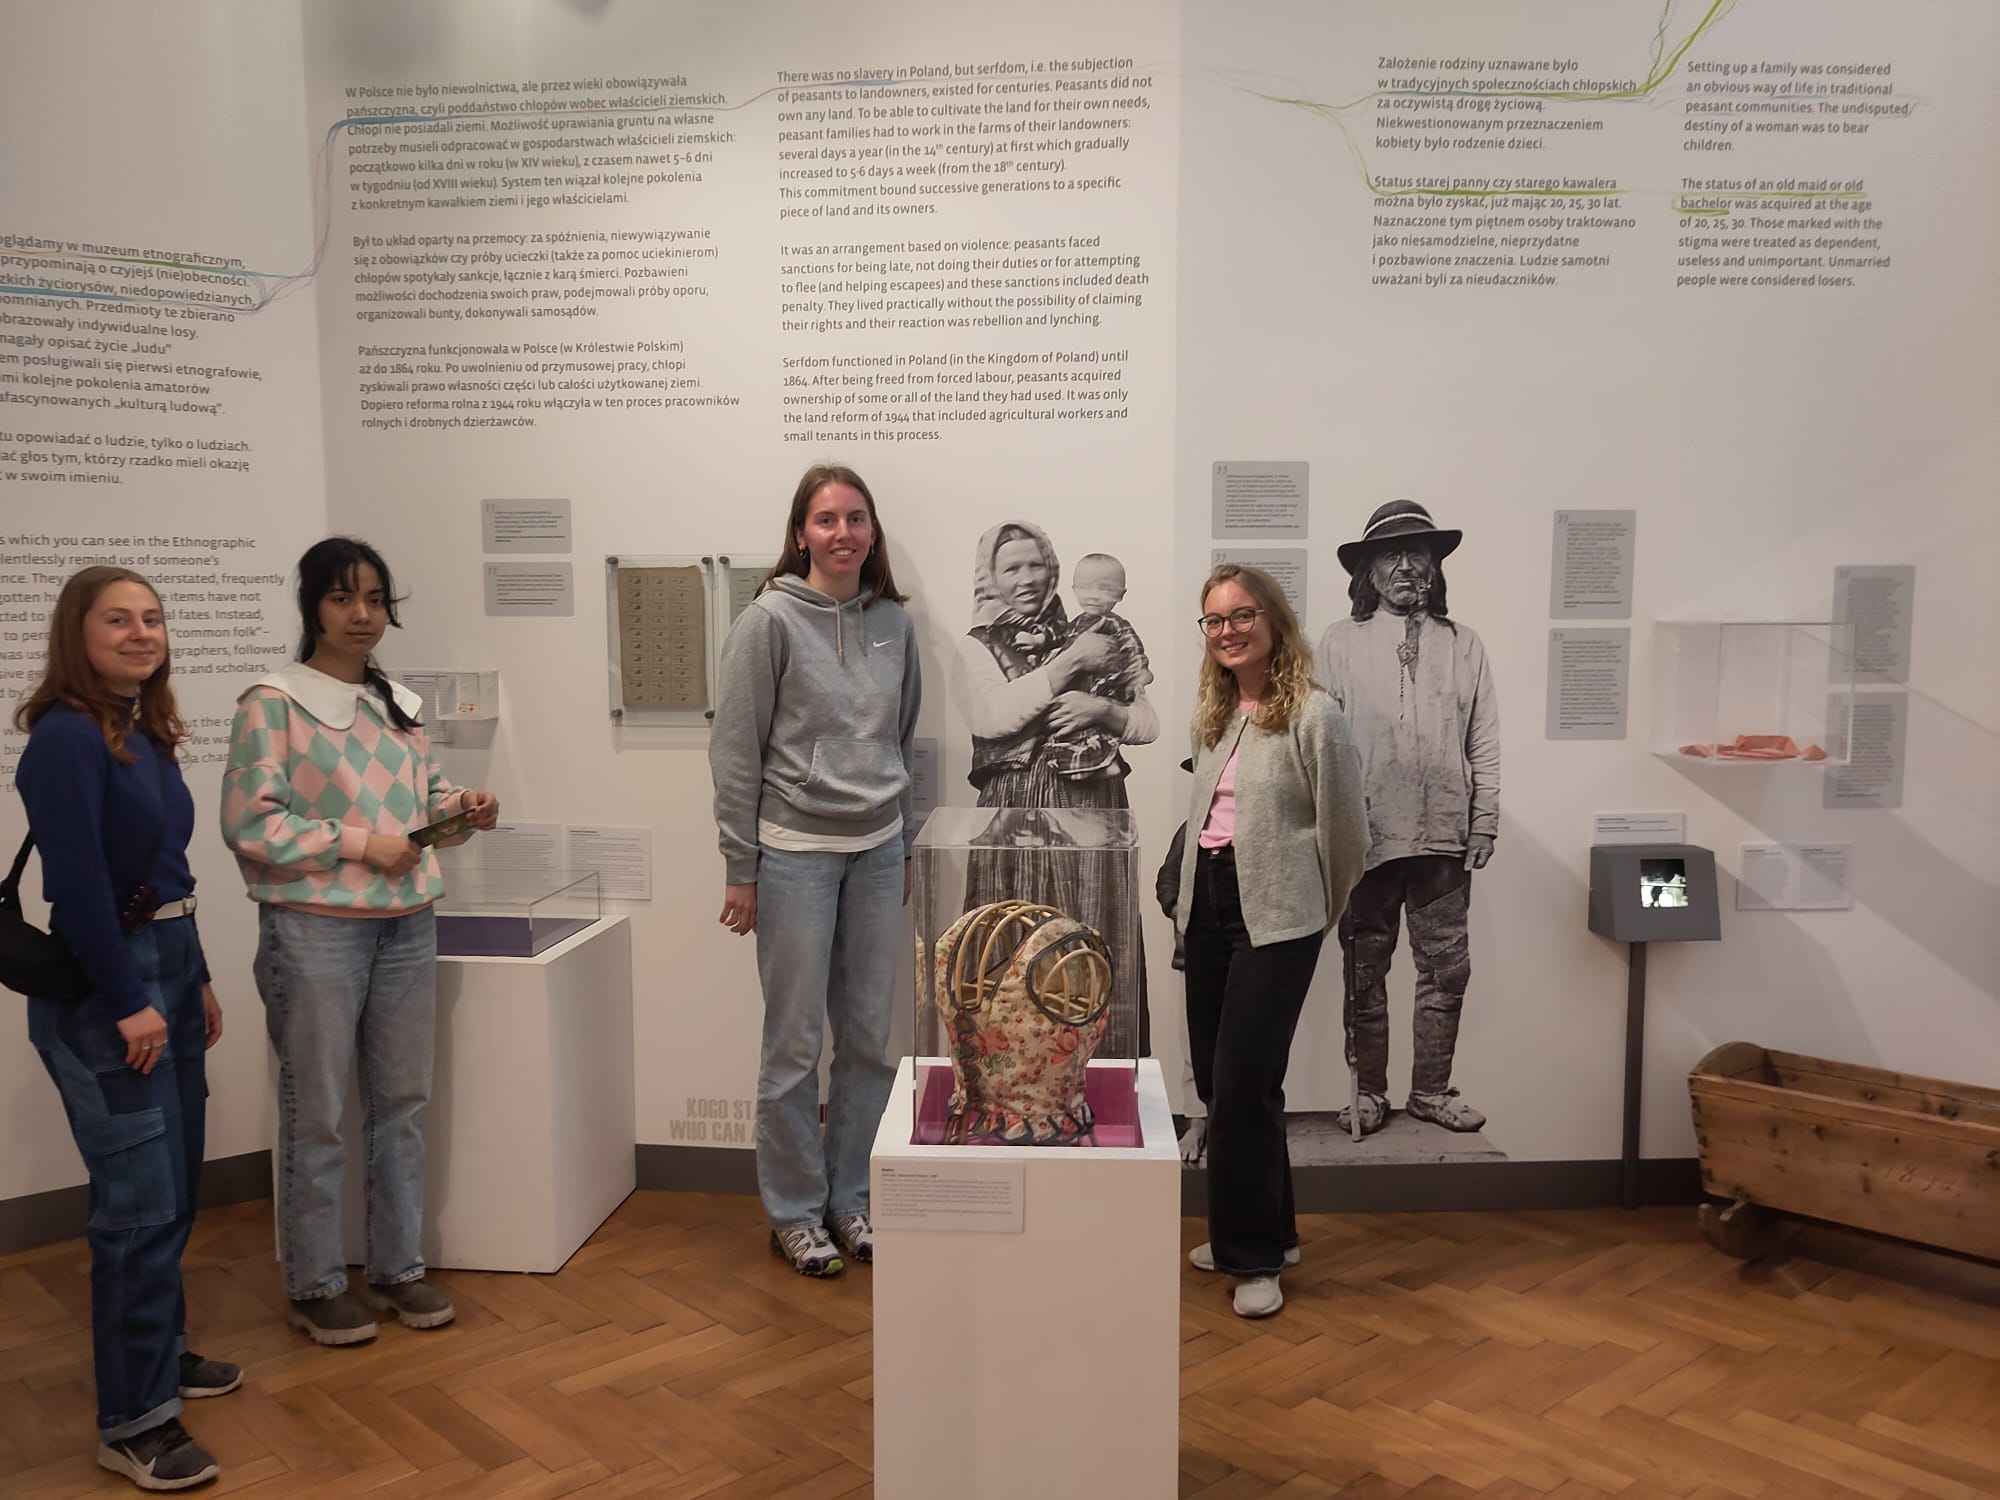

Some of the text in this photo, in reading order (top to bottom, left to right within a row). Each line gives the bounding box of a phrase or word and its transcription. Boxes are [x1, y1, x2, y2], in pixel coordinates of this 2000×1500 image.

[777, 55, 1133, 82] There was no slavery in Poland, but serfdom, i.e. the subjection
[1687, 59, 1891, 76] Setting up a family was considered
[777, 74, 1152, 104] of peasants to landowners, existed for centuries. Peasants did not
[1685, 98, 1908, 116] peasant communities. The undisputed
[1376, 115, 1603, 132] Niekwestionowanym przeznaczeniem
[1375, 135, 1421, 150] kobiety
[1452, 135, 1505, 148] rodzenie
[1507, 136, 1544, 149] dzieci.
[1683, 137, 1734, 150] children.
[780, 175, 1121, 198] This commitment bound successive generations to a specific
[1682, 176, 1863, 190] The status of an old maid or old
[350, 201, 357, 210] z
[358, 196, 425, 213] konkretnym
[488, 193, 518, 206] ziemi
[520, 193, 524, 205] i
[526, 192, 550, 208] jego
[779, 202, 937, 220] piece of land and its owners.
[1373, 213, 1635, 230] Naznaczone tym piętnem osoby traktowano
[780, 234, 1100, 257] It was an arrangement based on violence: peasants faced
[1372, 233, 1579, 249] jako niesamodzielne, nieprzydatne
[1678, 234, 1880, 251] stigma were treated as dependent,
[1676, 272, 1855, 288] people were considered losers.
[356, 303, 598, 323] organizowali bunty, dokonywali samosądów.
[357, 342, 426, 359] Pańszczyzna
[510, 344, 520, 354] w
[523, 340, 558, 353] Polsce
[559, 340, 573, 356] (w
[575, 339, 634, 353] Królestwie
[636, 339, 683, 354] Polskim)
[782, 348, 1128, 367] Serfdom functioned in Poland (in the Kingdom of Poland) until
[103, 356, 122, 373] się
[125, 358, 172, 377] pierwsi
[21, 371, 210, 394] kolejne pokolenia amatorów
[15, 429, 91, 448] opowiadać
[150, 435, 183, 452] tylko
[783, 427, 941, 443] small tenants in this process.
[7, 532, 50, 545] which
[52, 536, 78, 548] you
[80, 536, 106, 546] can
[107, 537, 130, 546] see
[147, 534, 170, 547] the
[171, 534, 256, 550] Ethnographic
[68, 552, 219, 565] remind us of someone's
[687, 1098, 729, 1120] KOGO
[670, 1120, 706, 1140] WHO
[712, 1122, 746, 1143] CAN
